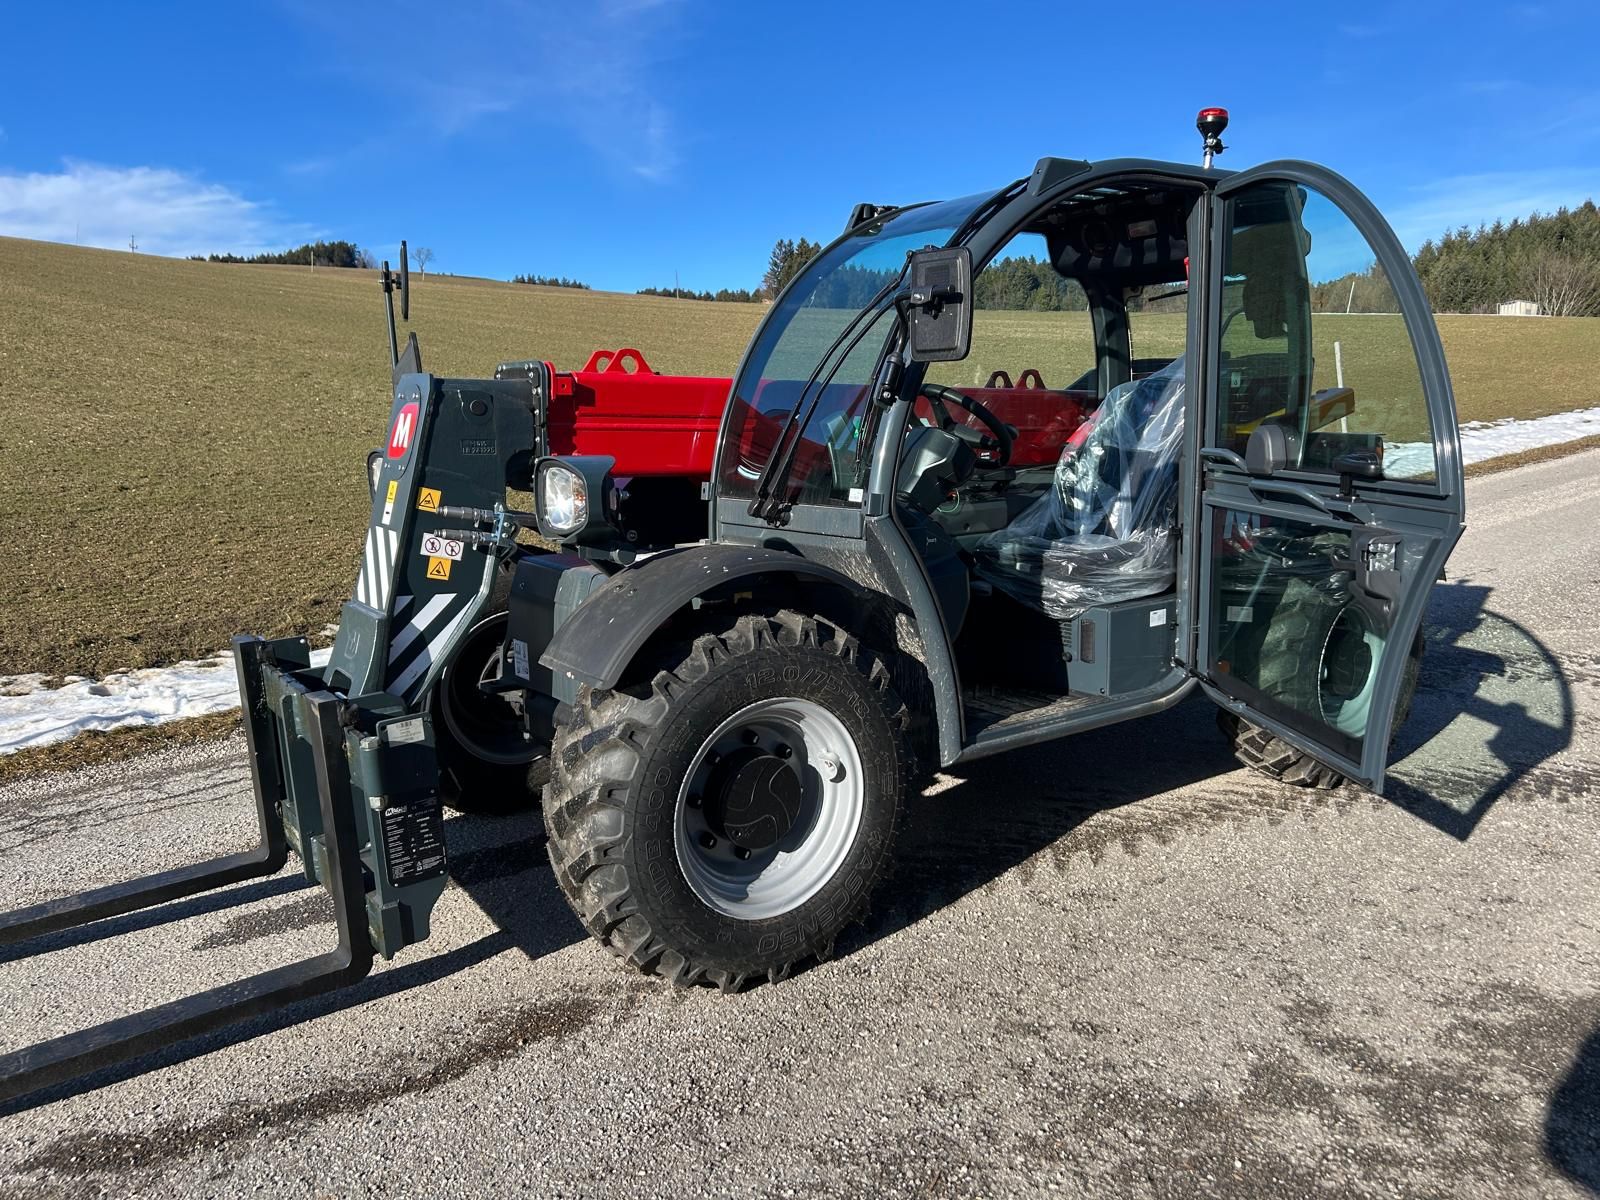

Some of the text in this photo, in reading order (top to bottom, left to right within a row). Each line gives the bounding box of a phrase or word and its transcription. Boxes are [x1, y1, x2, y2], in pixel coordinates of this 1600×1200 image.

[392, 412, 412, 448] M
[645, 766, 672, 832] 400
[757, 847, 874, 956] ASCENSO
